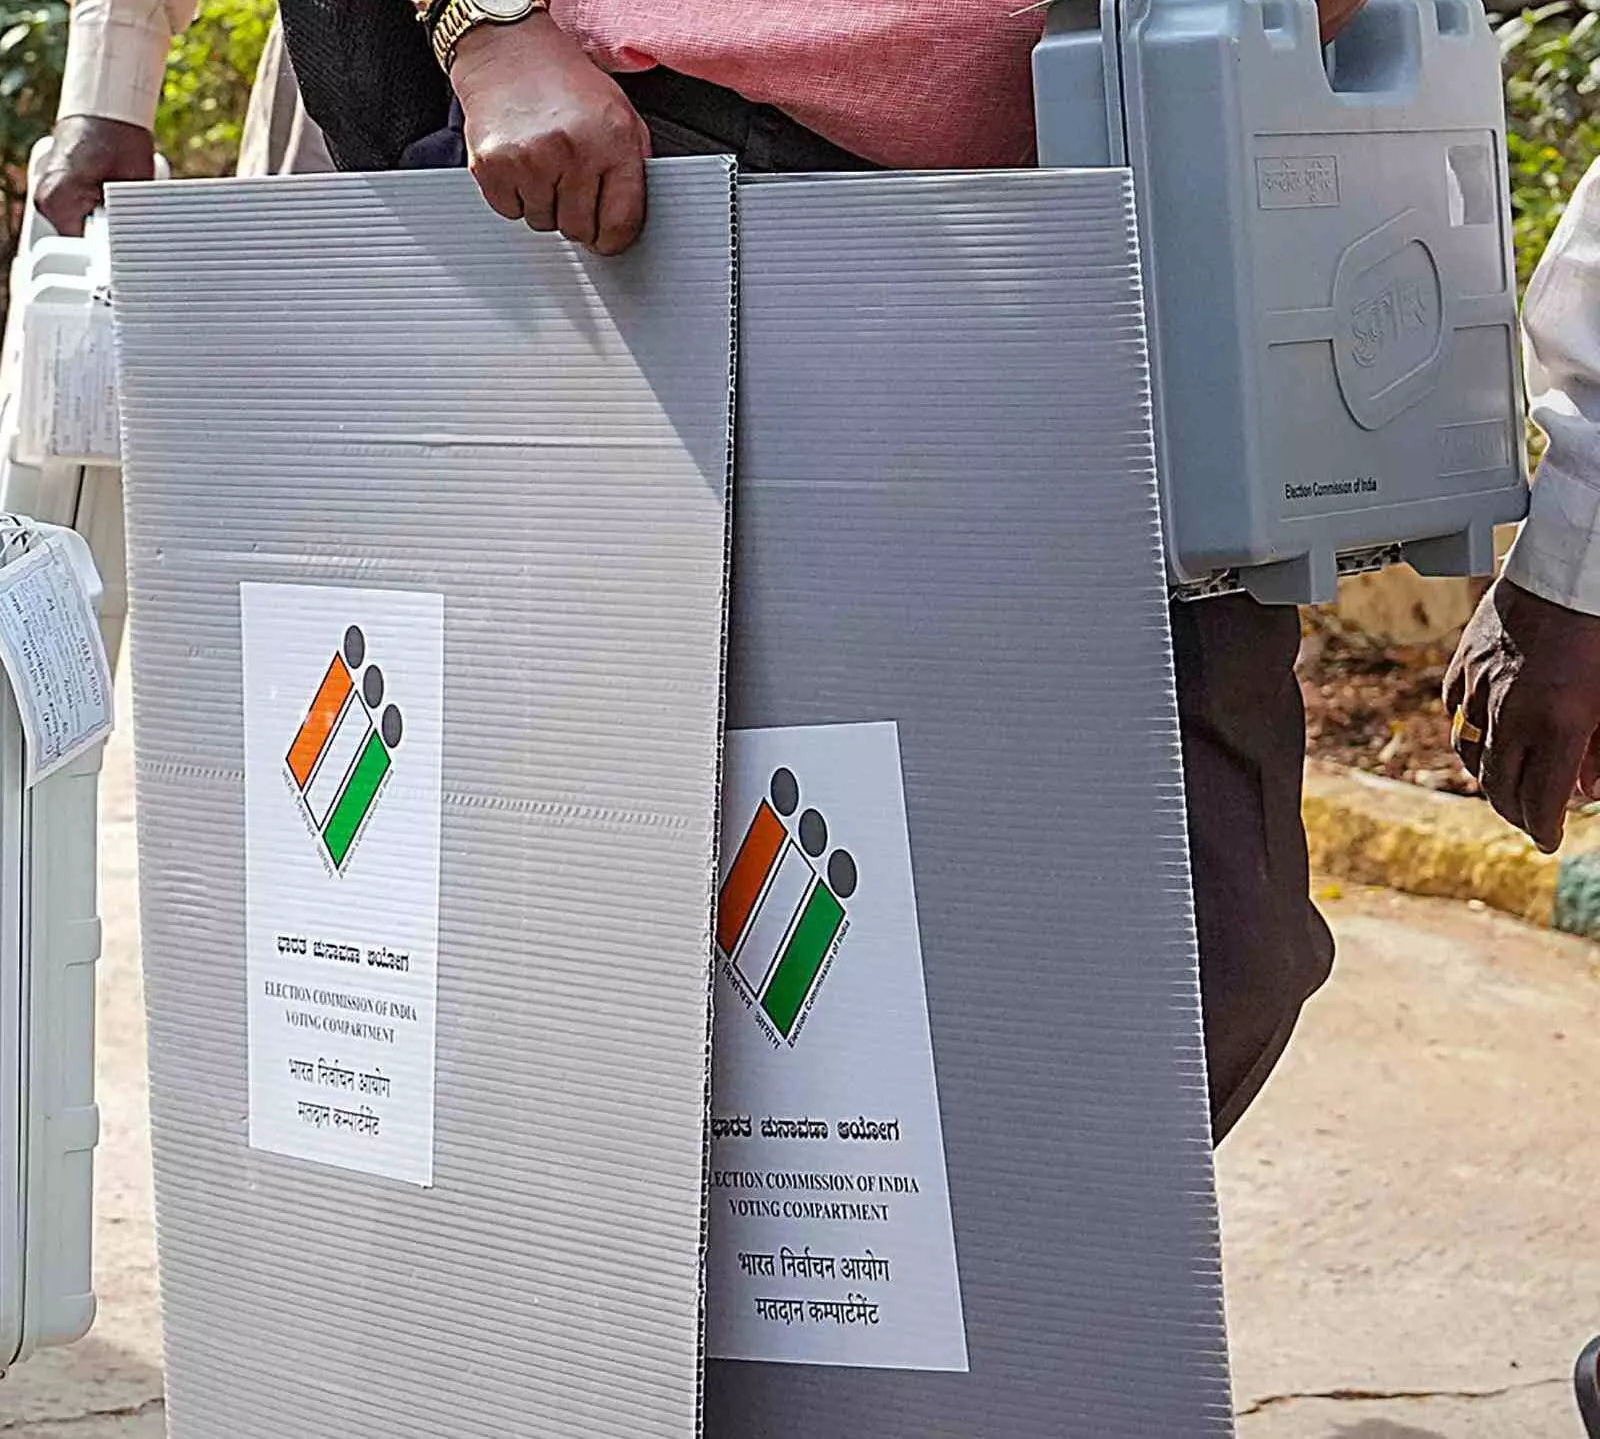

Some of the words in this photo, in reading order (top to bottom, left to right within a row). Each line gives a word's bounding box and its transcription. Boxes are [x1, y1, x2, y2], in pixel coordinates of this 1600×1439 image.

[1285, 483, 1312, 499] Election
[1312, 480, 1353, 496] Commission
[1361, 477, 1377, 491] India
[265, 981, 311, 1001] ELECTION
[313, 989, 375, 1013] COMMISSION
[375, 1001, 388, 1015] OF
[390, 1002, 417, 1021] INDIA
[285, 1010, 321, 1030] VOTING
[323, 1017, 395, 1043] COMPARTMENT
[289, 1058, 314, 1082] भारत
[318, 1057, 355, 1091] निर्वाचन
[359, 1067, 391, 1097] आयोग
[298, 1101, 330, 1128] मतदान
[708, 1171, 763, 1189] LECTION
[766, 1172, 853, 1192] COMMISSION
[857, 1175, 875, 1192] OF
[878, 1176, 919, 1193] INDIA
[729, 1199, 780, 1217] VOTING
[783, 1201, 889, 1221] COMPARTMENT
[738, 1252, 775, 1276] भारत
[780, 1246, 836, 1279] निर्वाचन
[840, 1249, 890, 1281] आयोग
[754, 1297, 804, 1325] मतदान
